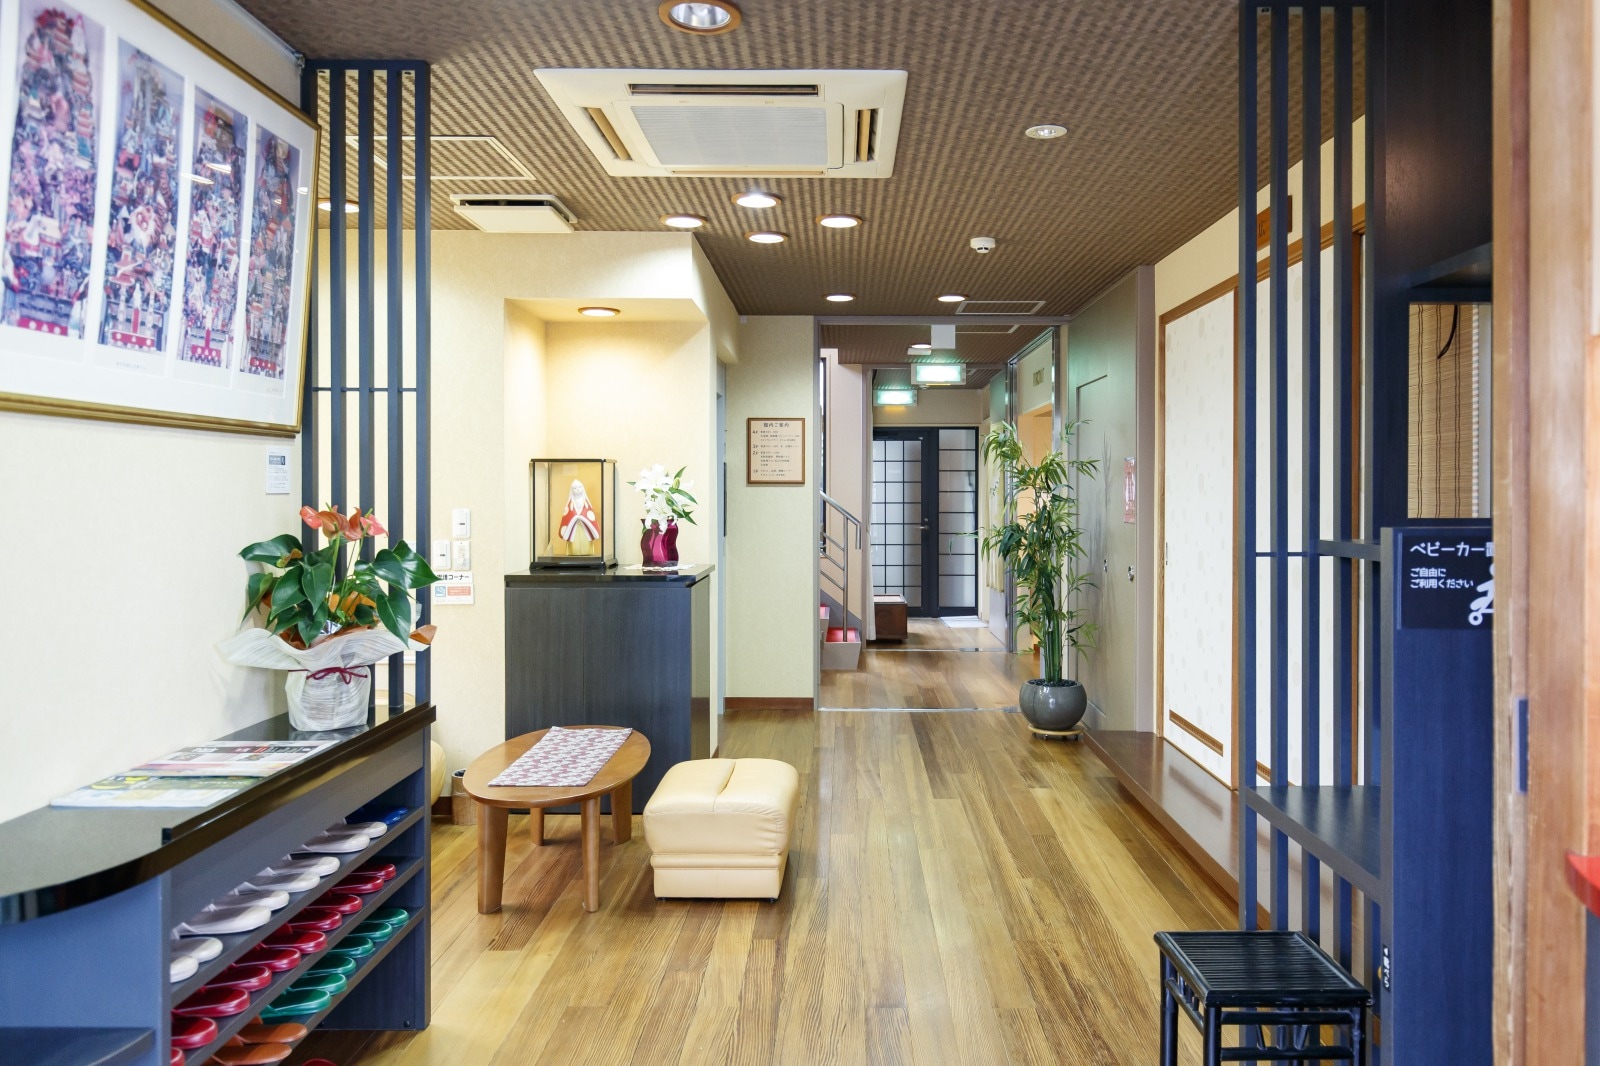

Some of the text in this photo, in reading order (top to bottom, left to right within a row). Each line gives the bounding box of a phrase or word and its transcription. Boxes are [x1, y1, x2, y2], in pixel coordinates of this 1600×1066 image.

[1409, 567, 1447, 577] ご自由に
[1409, 578, 1474, 589] ご利用ください
